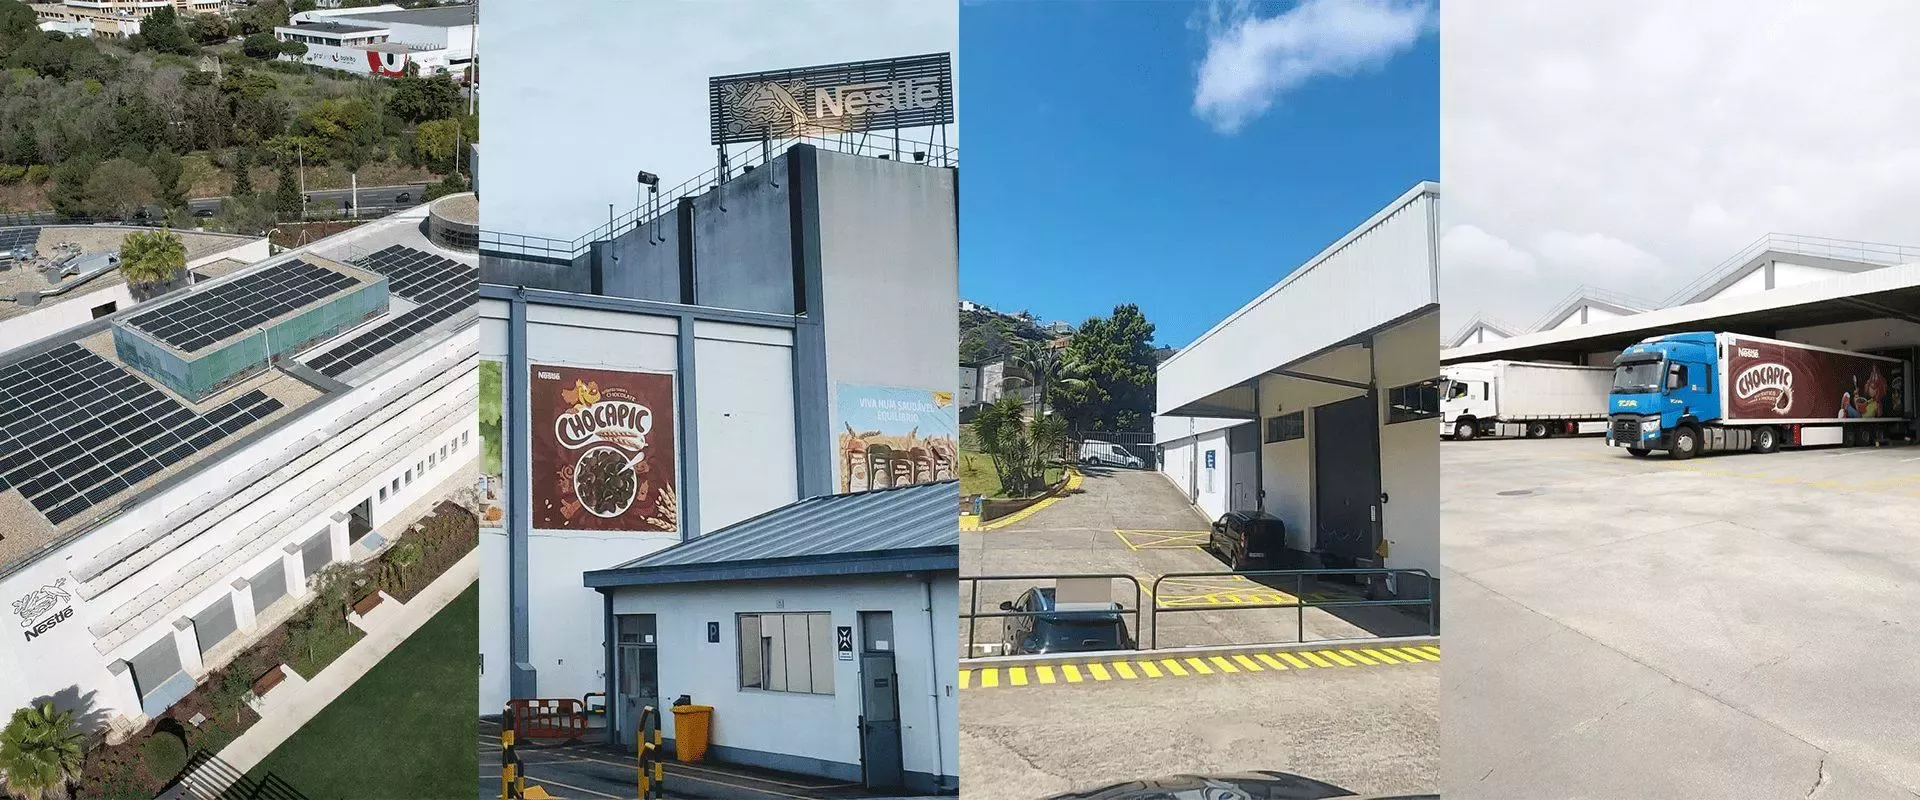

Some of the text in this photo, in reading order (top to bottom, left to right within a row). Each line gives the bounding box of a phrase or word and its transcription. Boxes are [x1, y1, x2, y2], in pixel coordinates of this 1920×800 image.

[815, 76, 940, 118] Nestlé
[1738, 366, 1790, 396] CHOCAPIC
[859, 398, 877, 408] VIVA
[557, 403, 649, 446] CHOCAPIC
[24, 605, 74, 642] Nestlé
